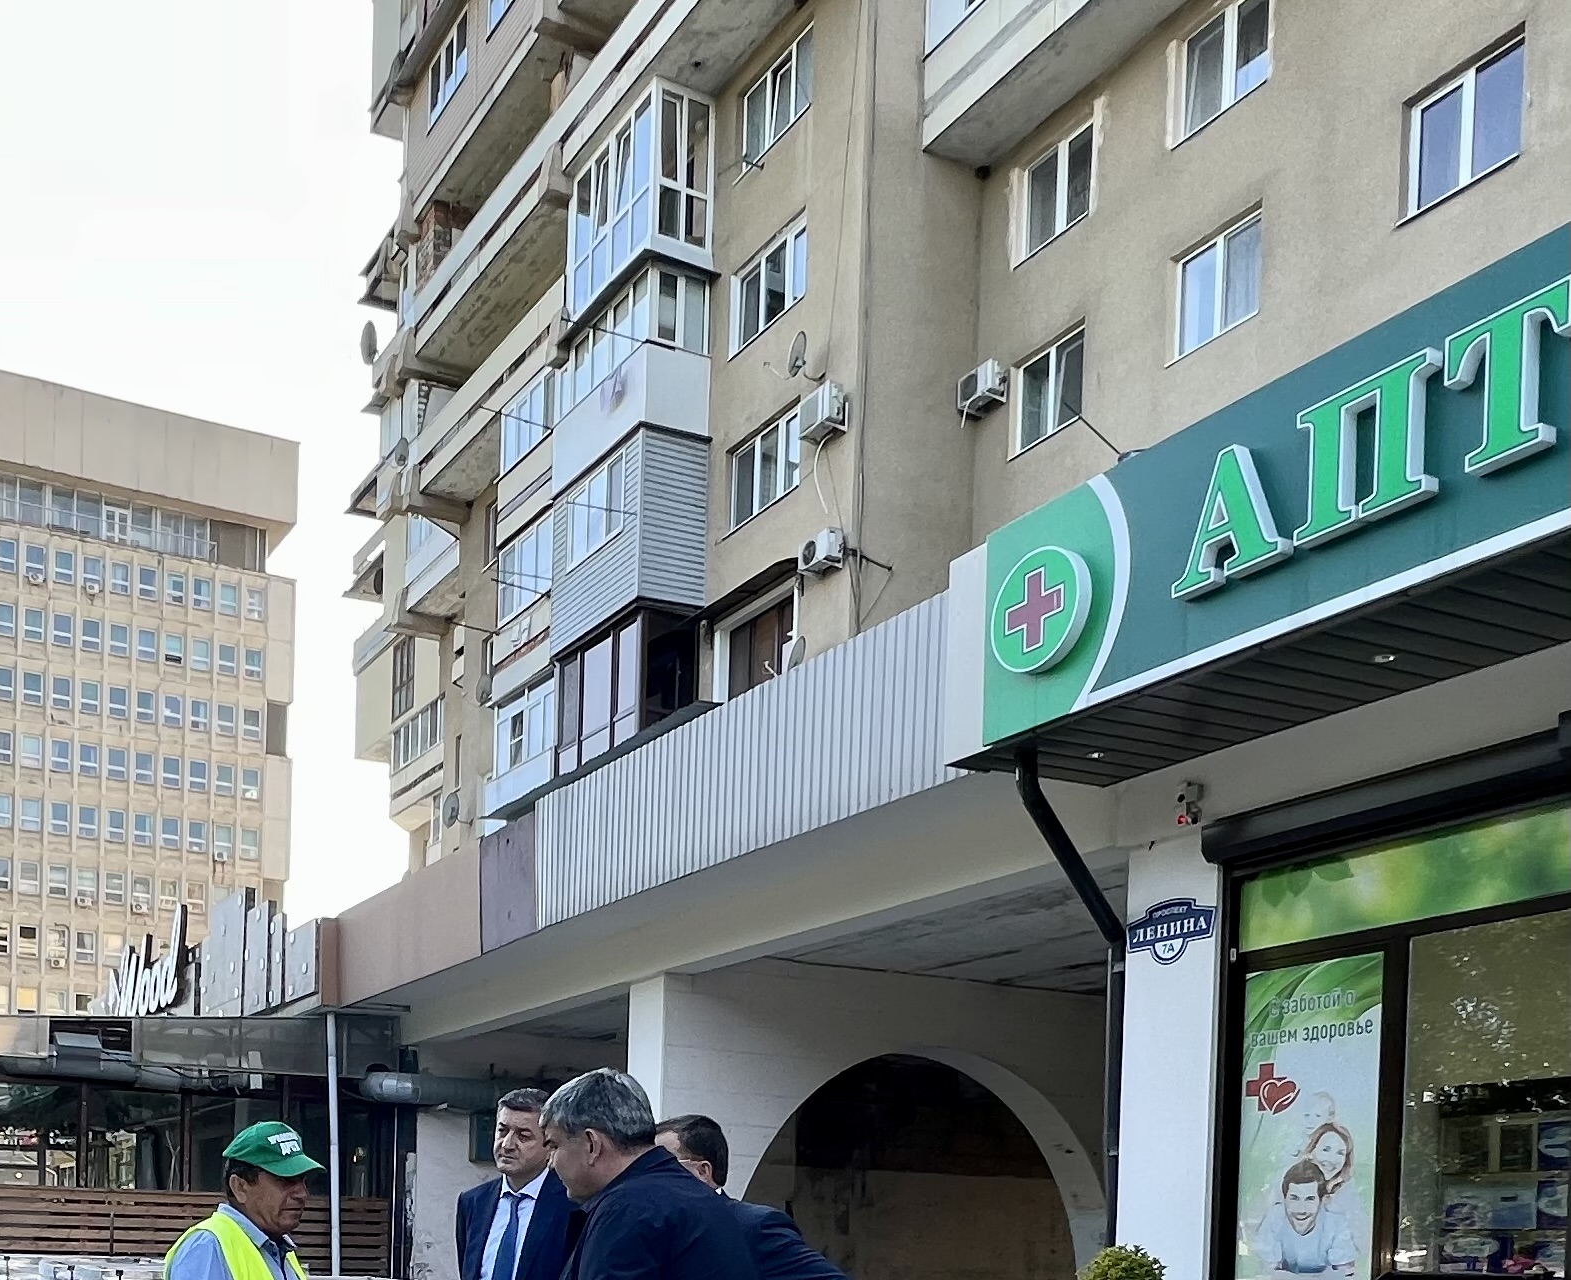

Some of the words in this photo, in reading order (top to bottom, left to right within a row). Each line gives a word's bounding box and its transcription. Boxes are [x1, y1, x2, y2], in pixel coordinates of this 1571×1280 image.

[1171, 275, 1571, 601] АПТ
[1132, 915, 1208, 944] ЛЕНИНА
[1161, 942, 1176, 955] 7А
[1281, 987, 1342, 1016] заботой
[1345, 990, 1356, 1008] о
[1250, 1028, 1299, 1048] вашем
[1302, 1018, 1374, 1044] здоровье
